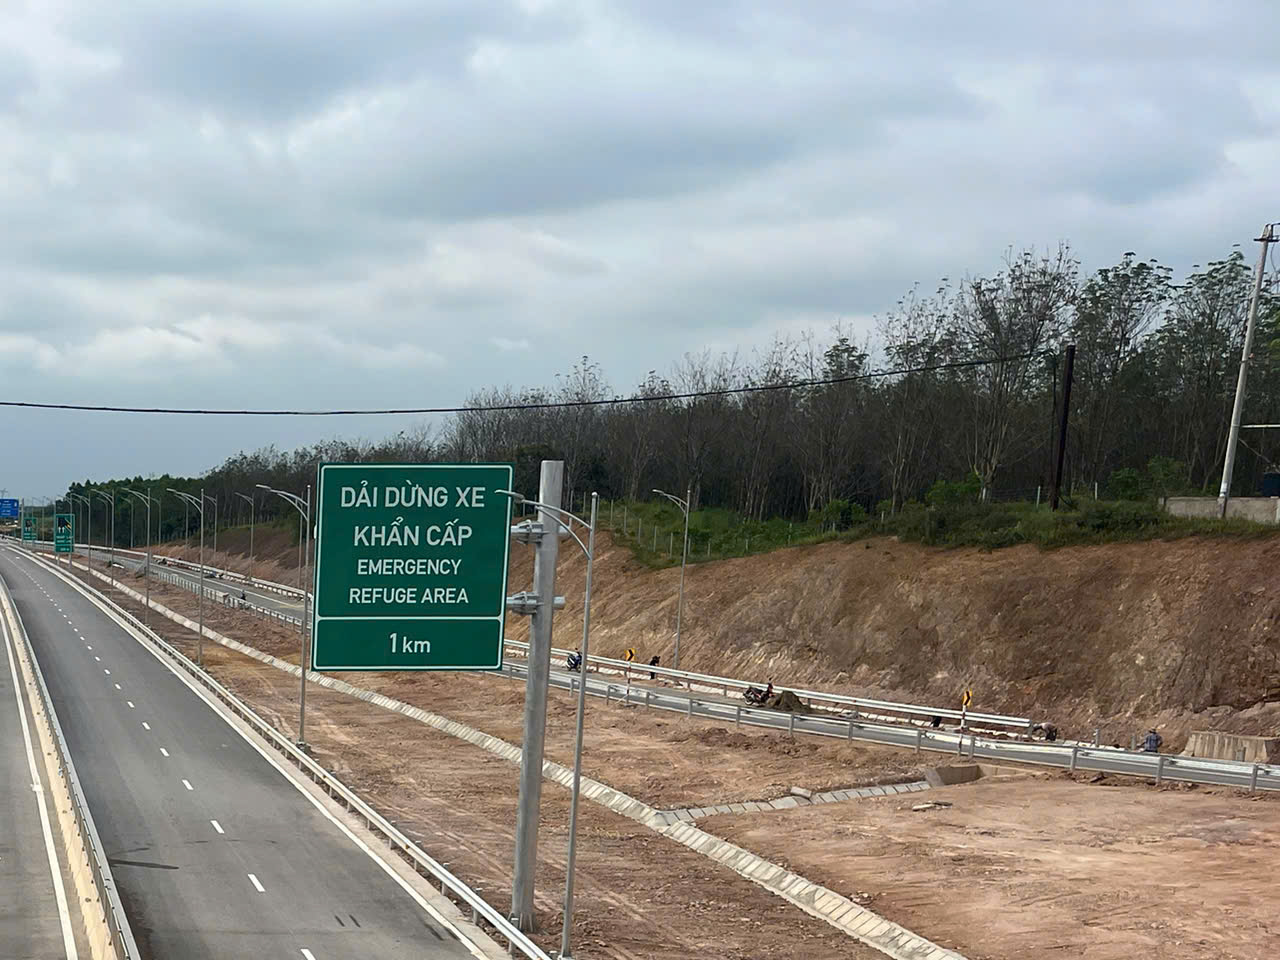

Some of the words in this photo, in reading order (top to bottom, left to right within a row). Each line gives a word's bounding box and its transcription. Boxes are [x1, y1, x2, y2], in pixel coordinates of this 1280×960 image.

[341, 480, 377, 507] DẢI
[385, 479, 448, 508] DỪNG
[456, 487, 486, 508] XE
[353, 516, 419, 546] KHẨN
[426, 518, 473, 546] CẤP
[357, 559, 462, 575] EMERGENCY
[349, 588, 417, 604] REFUGE
[421, 588, 469, 604] AREA
